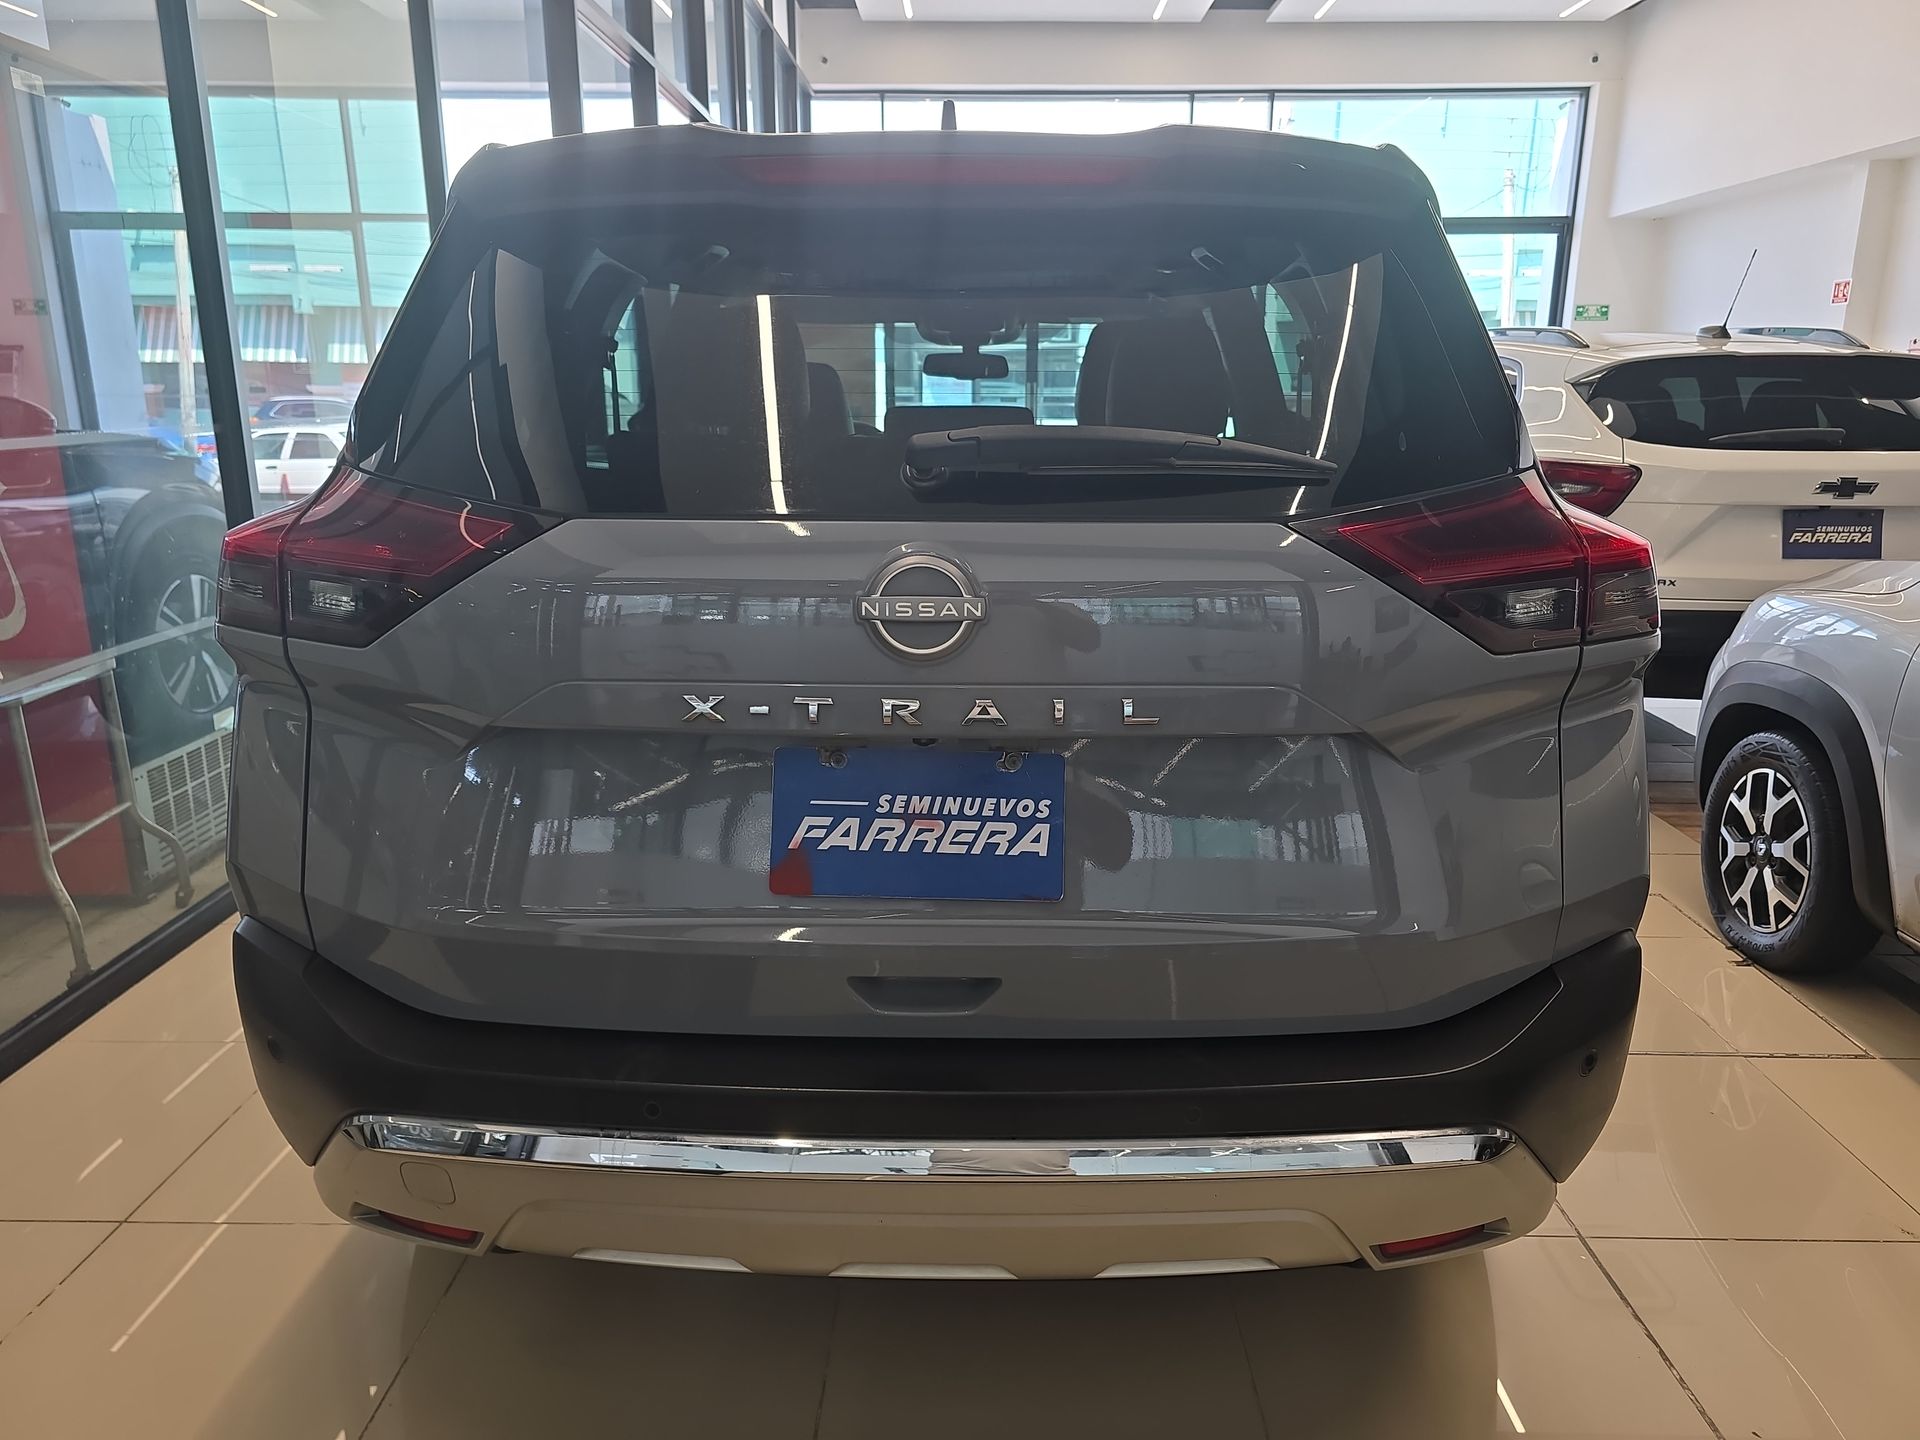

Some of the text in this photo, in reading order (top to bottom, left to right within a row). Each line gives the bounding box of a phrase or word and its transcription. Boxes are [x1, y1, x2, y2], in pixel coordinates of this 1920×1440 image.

[1788, 532, 1873, 543] FARRERA
[1657, 579, 1677, 587] AX
[861, 601, 982, 618] NISSAN
[681, 694, 1160, 727] X-TRAIL
[875, 794, 1052, 819] SEMINUEVOS
[788, 816, 1052, 857] FARRERA
